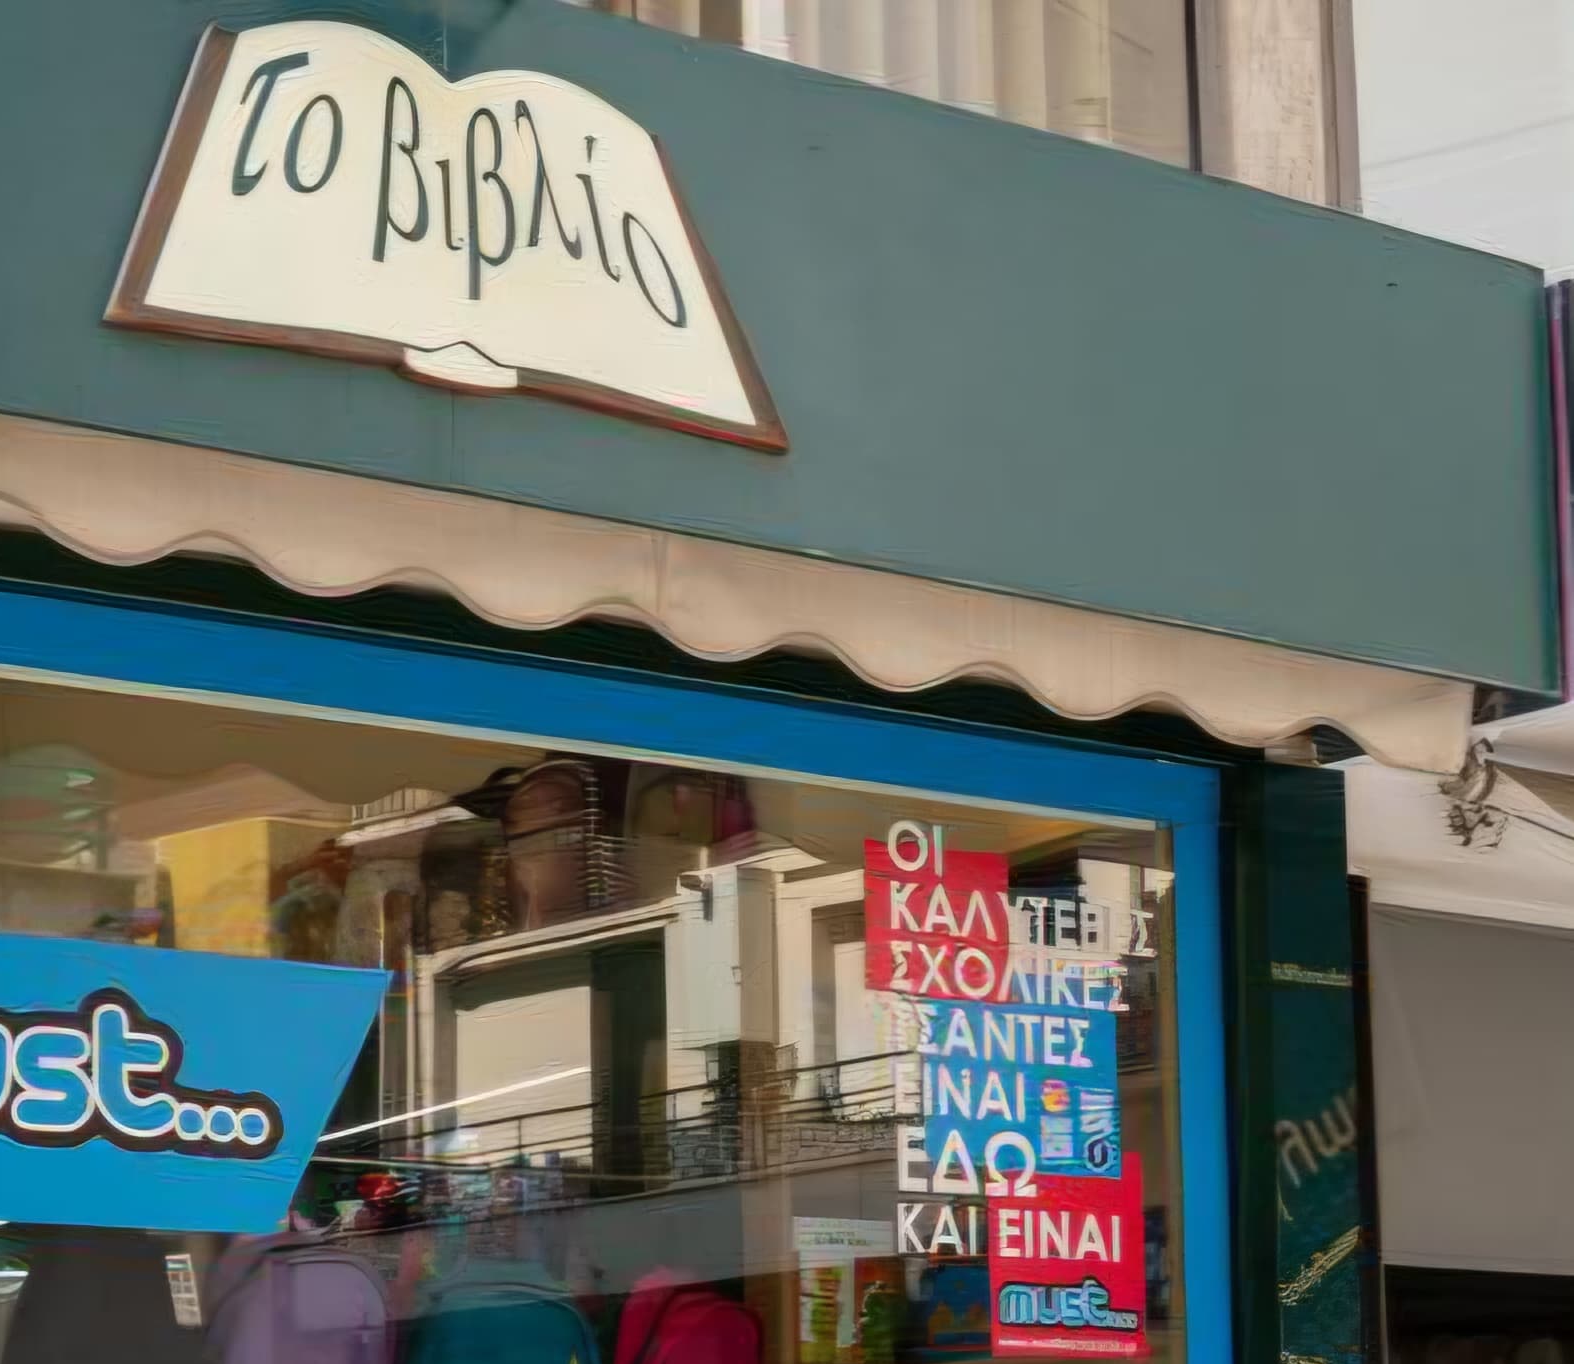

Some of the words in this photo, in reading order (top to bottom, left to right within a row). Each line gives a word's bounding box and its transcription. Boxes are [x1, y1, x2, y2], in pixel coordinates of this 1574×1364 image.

[232, 51, 343, 196] το
[372, 76, 688, 329] βιβλίο
[887, 819, 944, 877] ΟΙ
[892, 998, 1094, 1068] ΣΑΝΤΕΣ
[896, 1202, 977, 1256] ΚΑΙ
[997, 1208, 1122, 1264] ΕΙΝΑΙ
